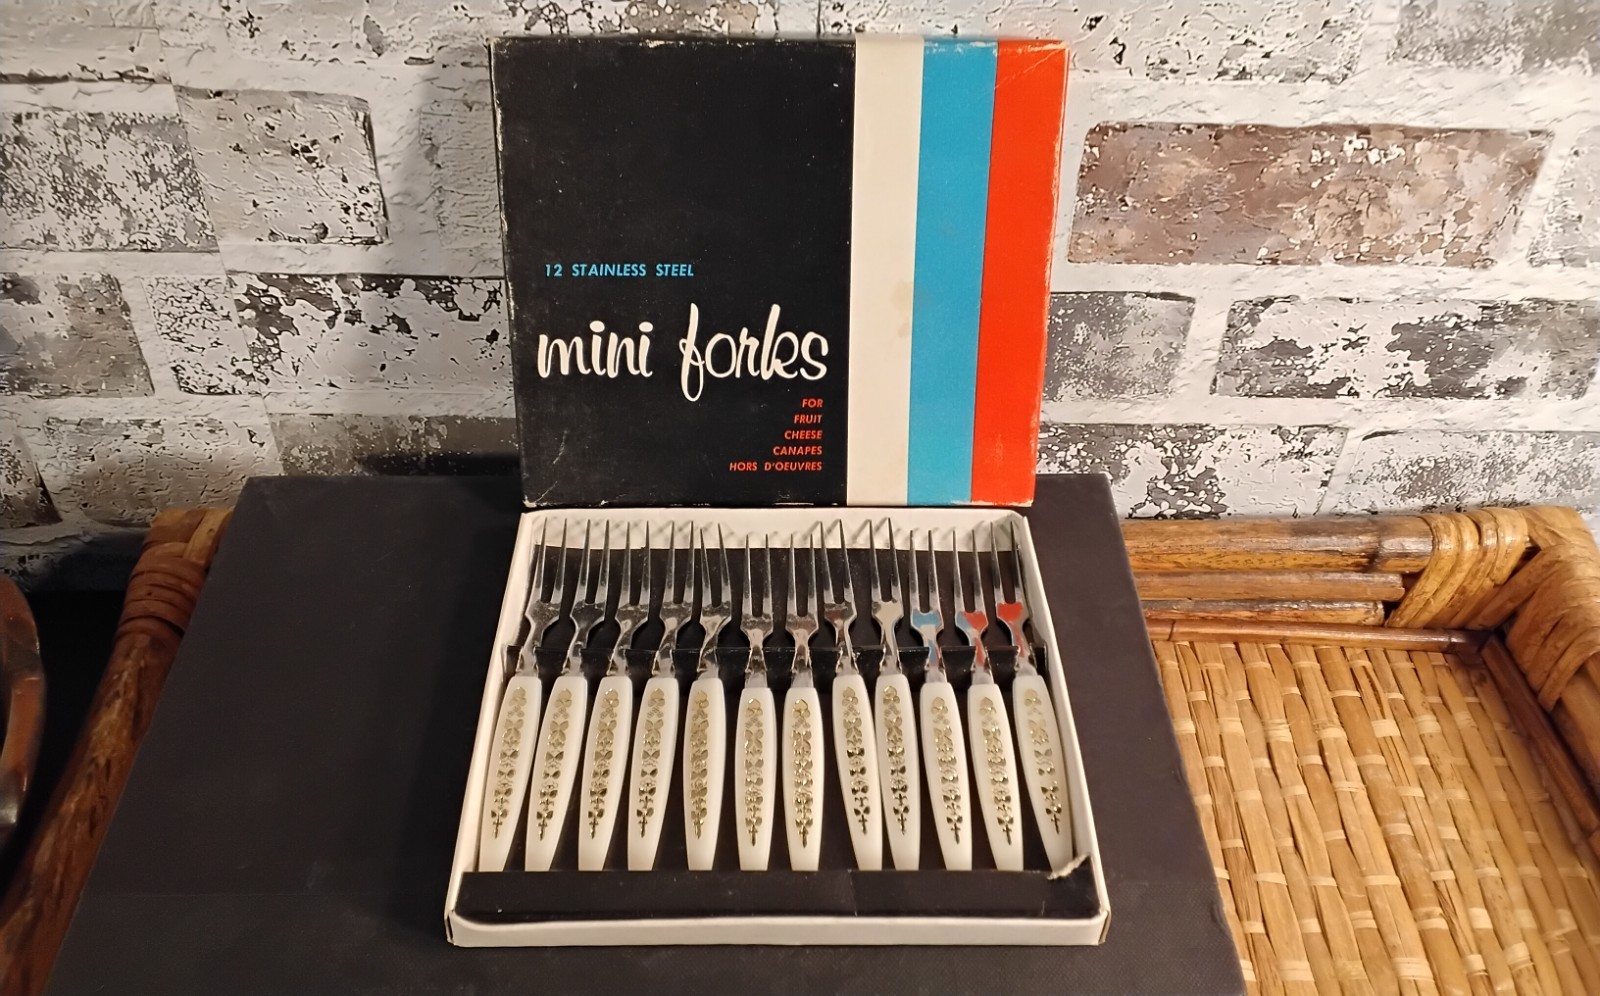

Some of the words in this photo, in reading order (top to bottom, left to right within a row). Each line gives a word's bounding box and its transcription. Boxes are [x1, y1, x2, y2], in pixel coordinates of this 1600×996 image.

[545, 263, 563, 277] 12
[571, 263, 647, 277] STAINLESS
[655, 263, 695, 277] STEEL
[537, 320, 654, 379] mini
[678, 302, 829, 402] forks
[801, 397, 824, 409] FOR
[793, 413, 823, 425] FRUIT
[783, 429, 823, 441] CHEESE
[772, 445, 823, 457] CANAPES
[729, 460, 758, 472] HORS
[763, 460, 823, 472] D'OEUVRES
